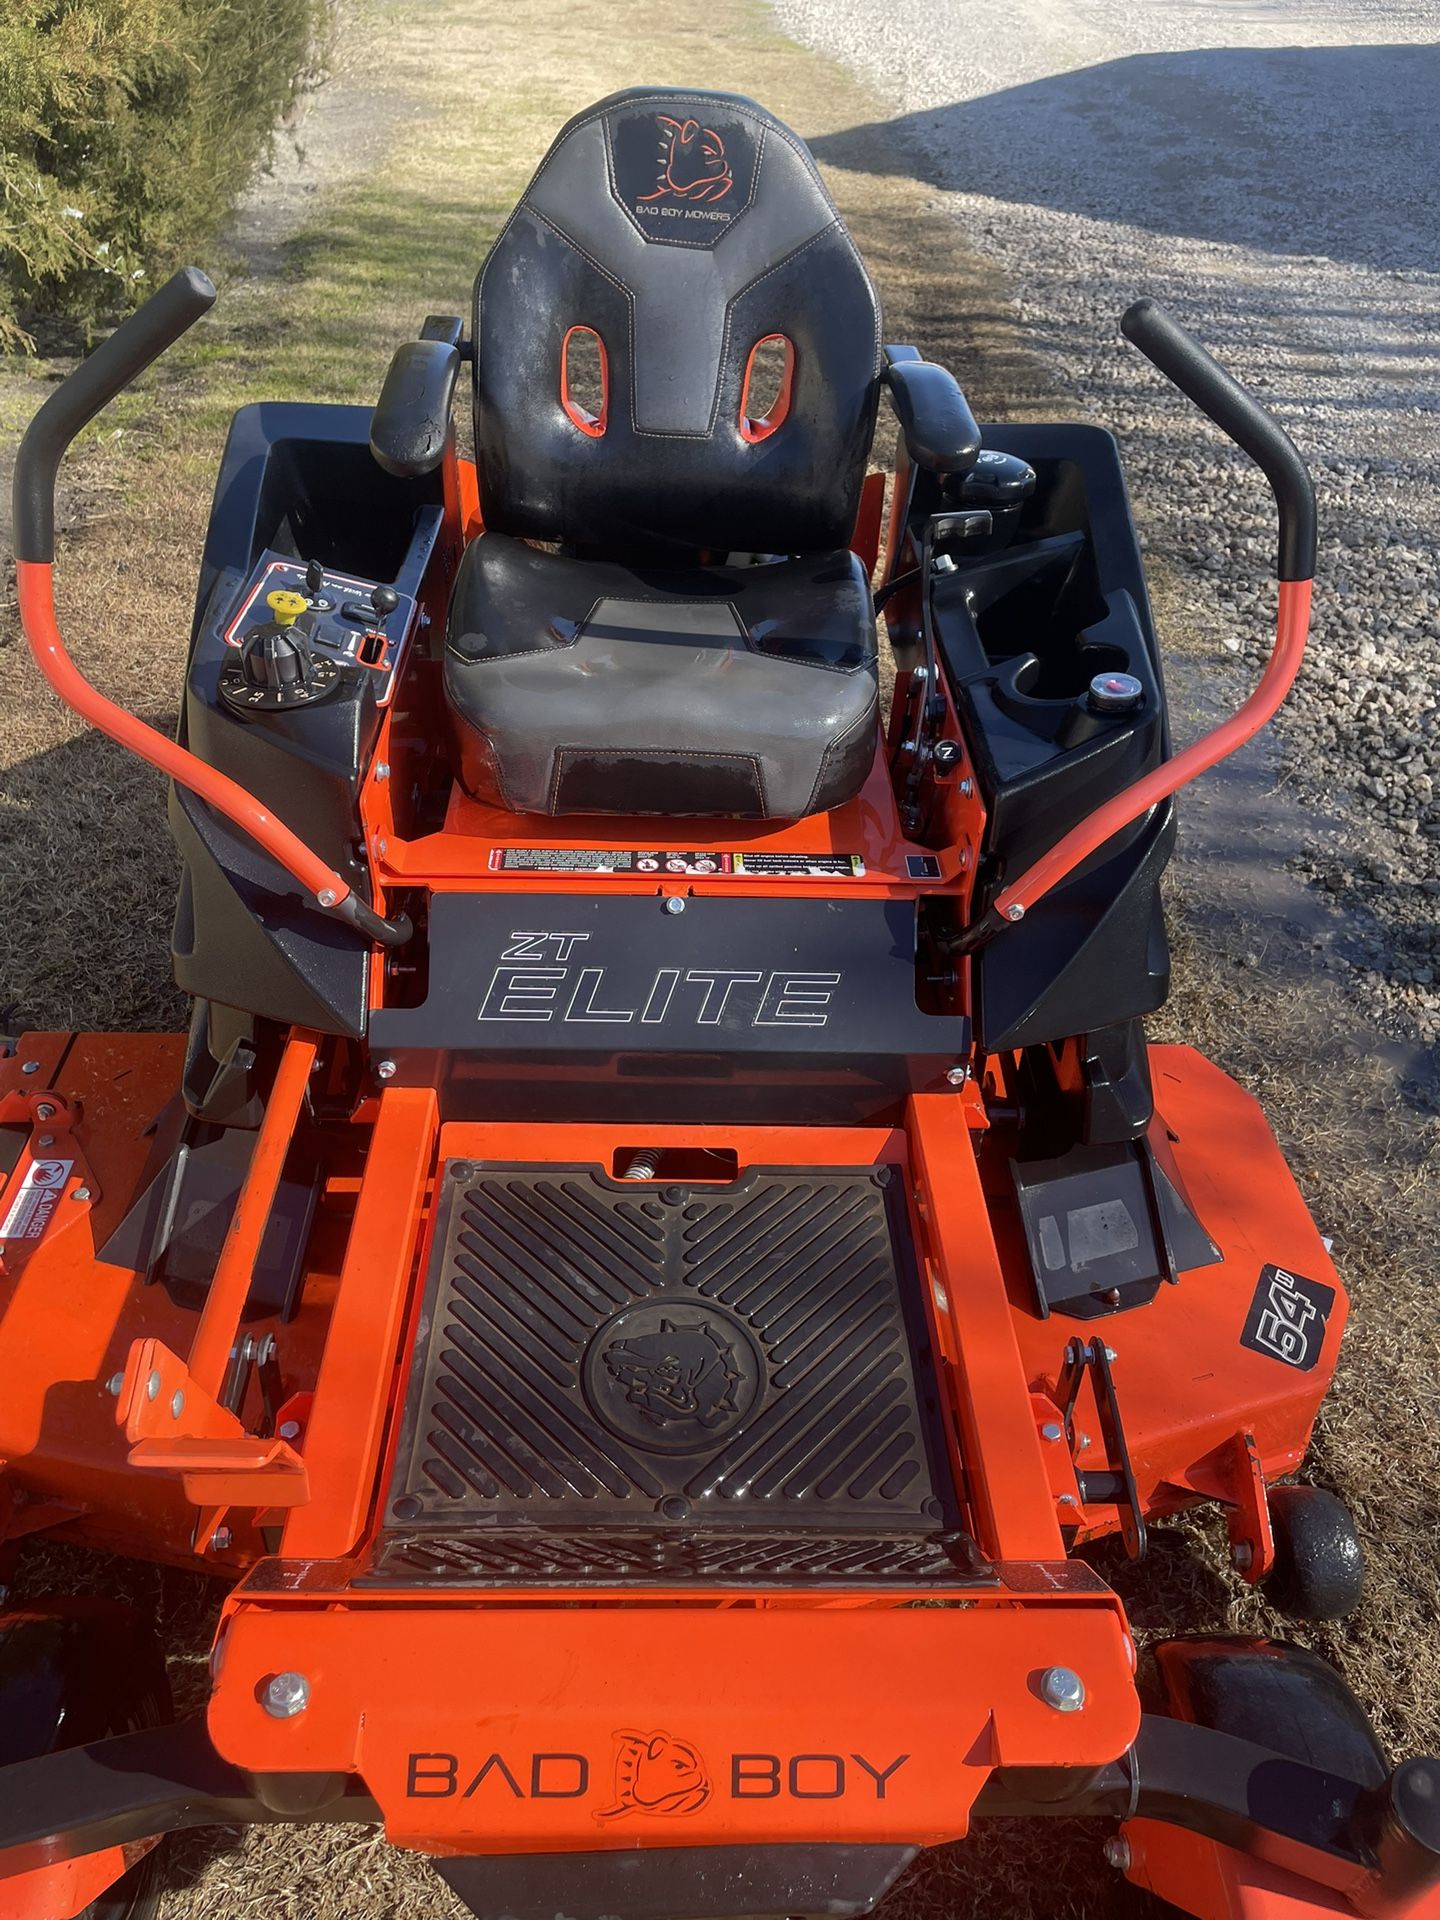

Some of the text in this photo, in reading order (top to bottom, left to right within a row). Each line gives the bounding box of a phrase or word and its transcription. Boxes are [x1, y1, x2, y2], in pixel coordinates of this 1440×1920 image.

[636, 205, 731, 221] BAD BOY MOWERS
[500, 931, 590, 961] ZT
[477, 966, 842, 1026] ELITE
[24, 1203, 54, 1238] DANGER
[1256, 1268, 1317, 1364] 54"
[406, 1752, 911, 1800] BAD BOY
